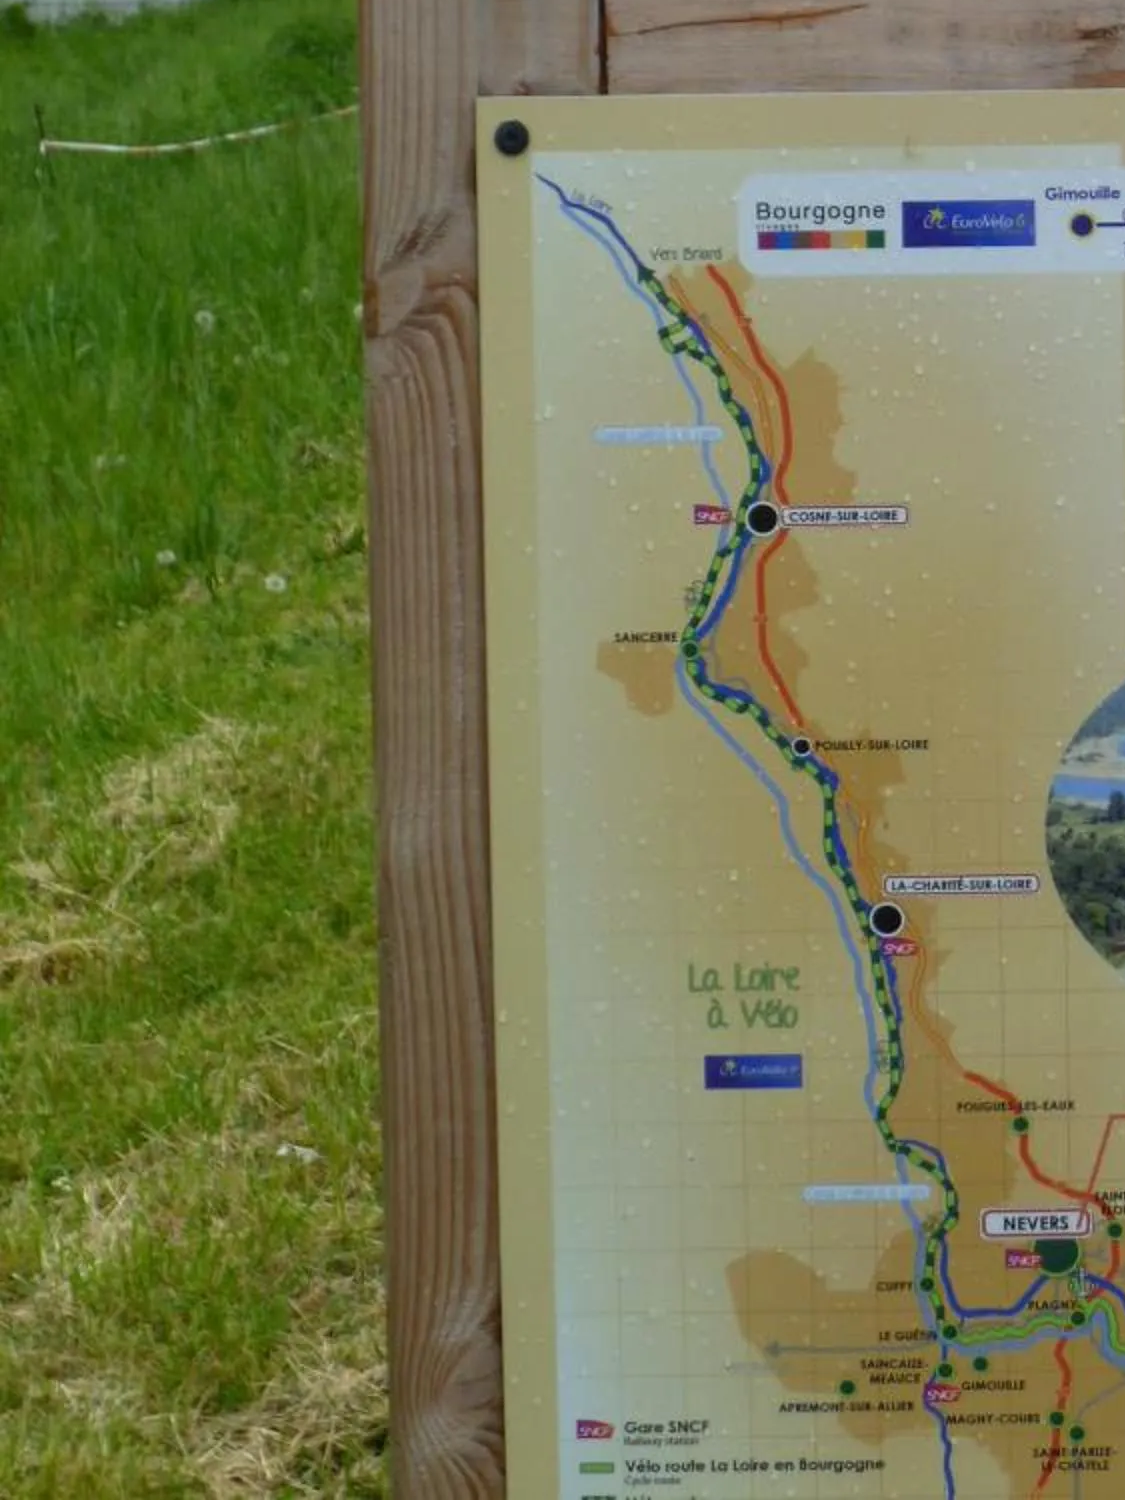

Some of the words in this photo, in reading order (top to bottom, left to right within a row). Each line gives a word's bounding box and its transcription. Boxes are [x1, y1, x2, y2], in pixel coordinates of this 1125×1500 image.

[1045, 186, 1121, 200] Gimouille
[755, 201, 886, 225] Bourgogne
[788, 509, 899, 523] COSNE-SUR-LOIRE
[614, 631, 679, 644] SANCERRE
[688, 962, 724, 993] La
[734, 960, 800, 992] Loire
[707, 997, 729, 1029] à
[740, 998, 799, 1029] Vélo
[1003, 1215, 1070, 1232] NEVERS
[624, 1421, 664, 1434] Gare
[668, 1420, 710, 1434] SNCF
[625, 1459, 661, 1473] Vélo
[665, 1459, 705, 1473] route
[711, 1459, 729, 1472] La
[733, 1458, 768, 1472] Loire
[774, 1460, 796, 1472] en
[799, 1457, 886, 1474] Bourgogne
